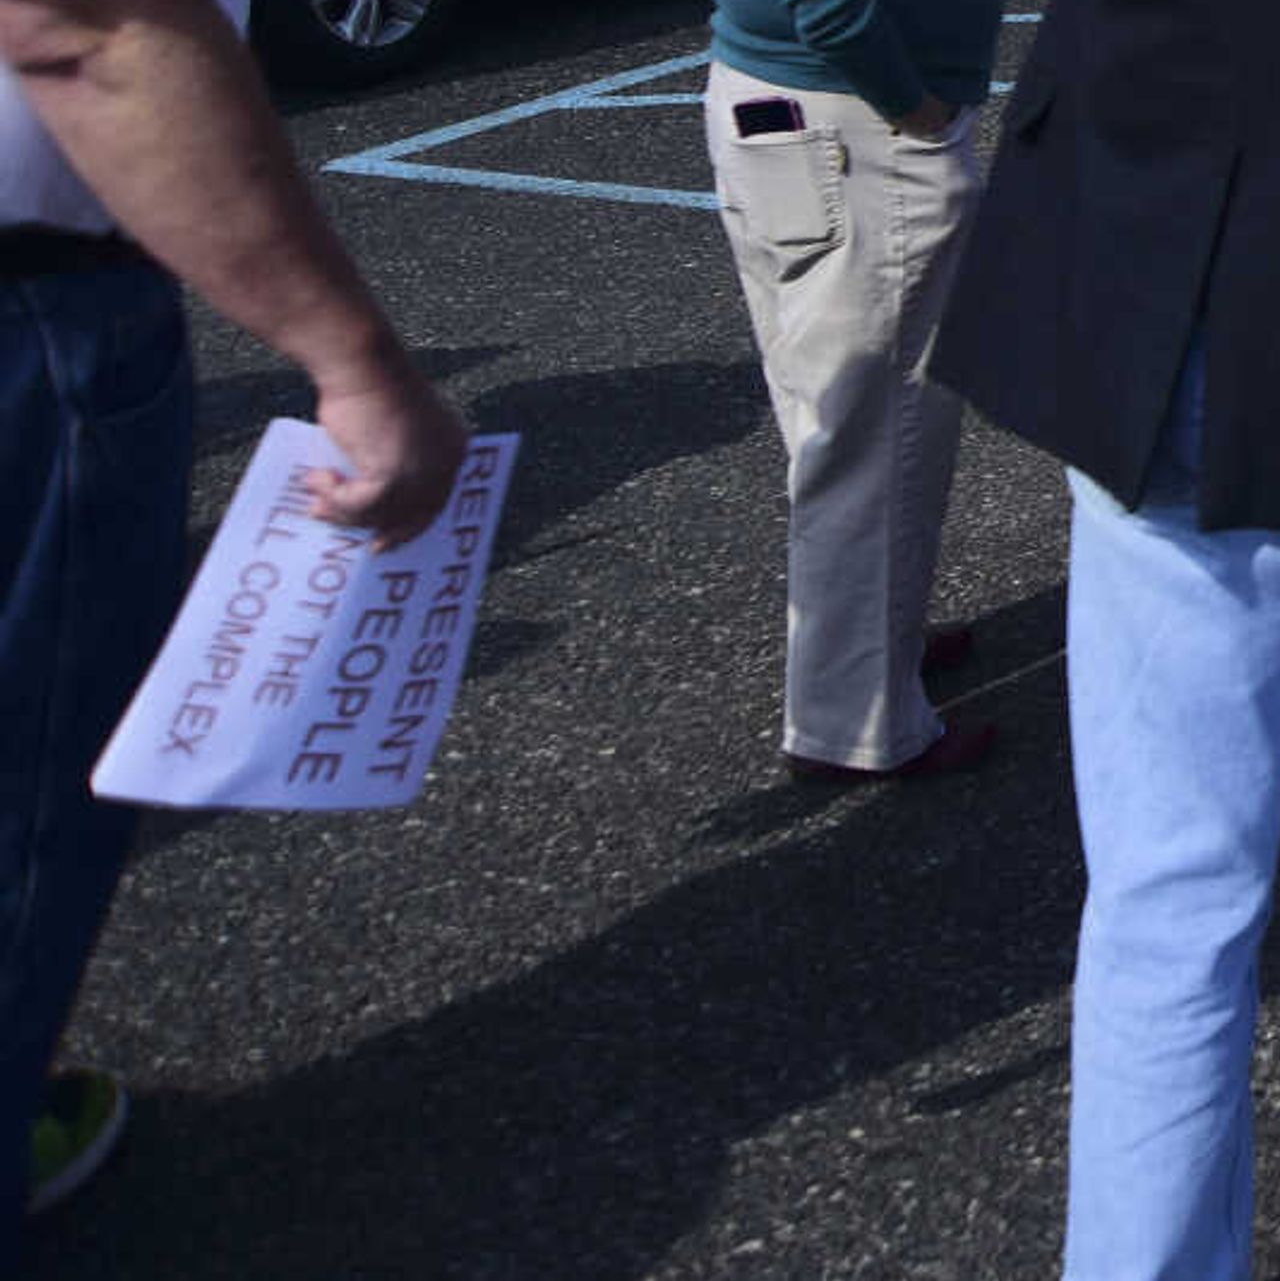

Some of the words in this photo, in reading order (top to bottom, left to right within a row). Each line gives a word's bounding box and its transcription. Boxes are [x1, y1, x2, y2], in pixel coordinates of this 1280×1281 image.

[157, 561, 280, 757] COMPLEX
[253, 636, 321, 709] THE
[294, 534, 367, 620] NOT
[369, 445, 499, 782] REPRESENT
[288, 571, 418, 785] PEOPLE
